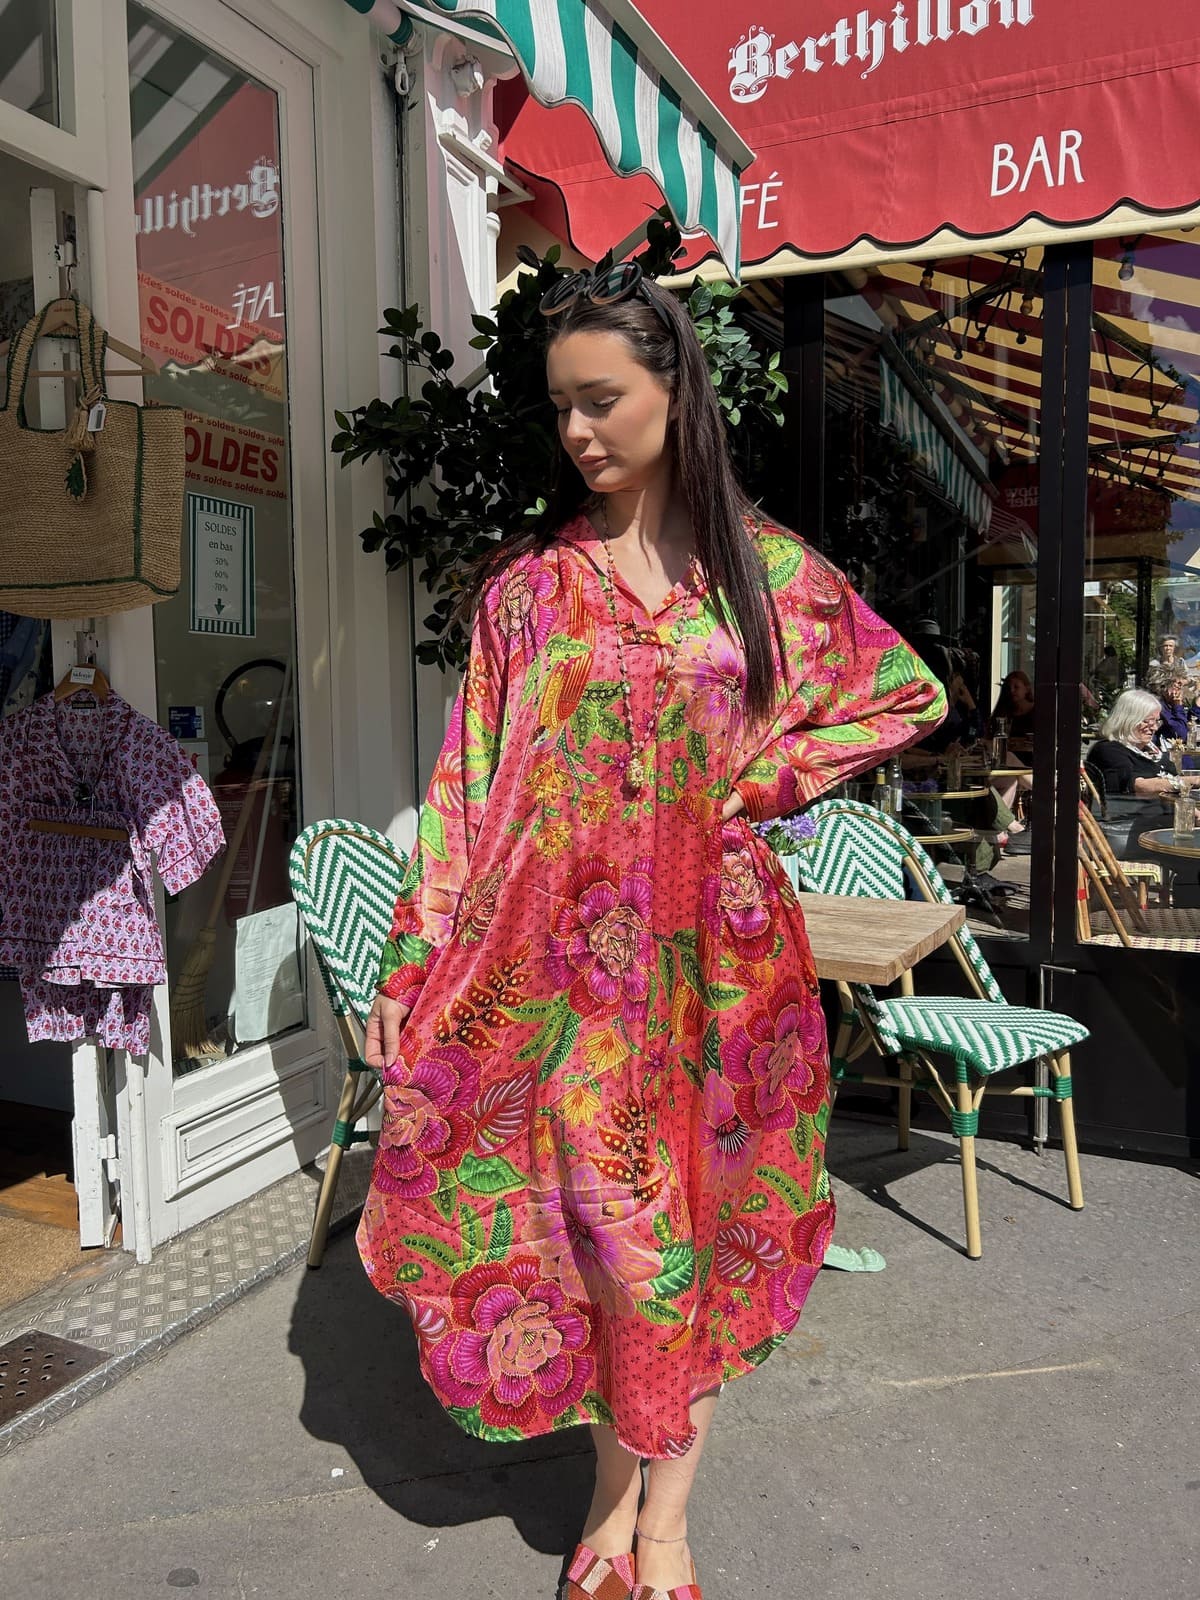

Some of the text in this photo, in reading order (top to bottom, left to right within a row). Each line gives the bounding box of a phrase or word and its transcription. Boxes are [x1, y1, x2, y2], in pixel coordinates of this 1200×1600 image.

[740, 130, 1085, 231] FÉ BAR
[185, 426, 278, 482] OLDES
[204, 521, 237, 537] SOLDES
[209, 540, 233, 552] en bas
